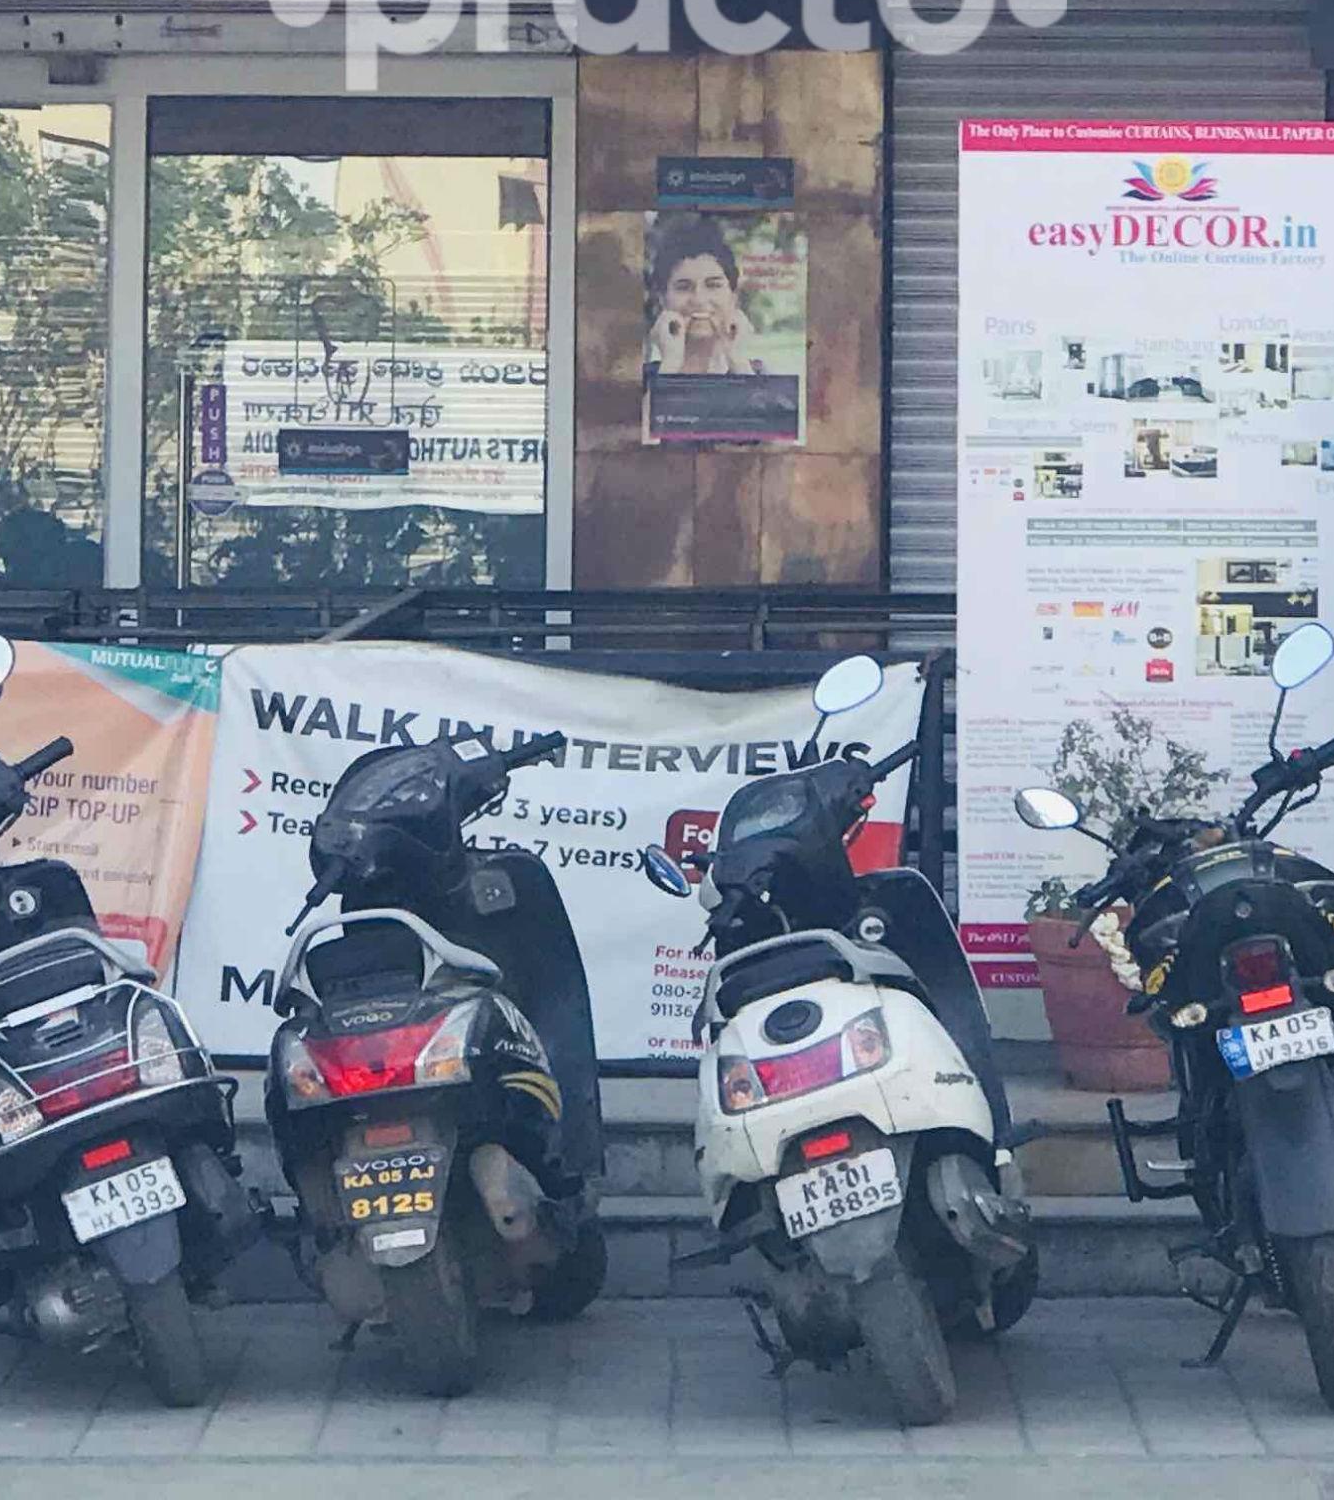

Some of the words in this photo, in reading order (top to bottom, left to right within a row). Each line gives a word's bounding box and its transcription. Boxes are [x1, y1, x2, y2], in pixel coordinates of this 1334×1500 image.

[1029, 214, 1318, 257] easyDECOR.in
[984, 316, 1037, 336] Paris
[90, 650, 165, 671] MUTUAL
[251, 688, 419, 748] WALK
[81, 772, 158, 795] number
[25, 794, 60, 818] SIP
[66, 798, 141, 825] TOP-UP
[513, 799, 530, 819] 3
[540, 804, 628, 831] years)
[268, 811, 315, 837] Tea
[558, 845, 646, 872] years)
[655, 945, 684, 959] For
[654, 964, 707, 980] Please
[1250, 1023, 1281, 1043] KA
[1287, 1013, 1319, 1035] 05
[343, 1173, 375, 1190] KA
[408, 1166, 435, 1182] AJ
[353, 1154, 427, 1174] VOGO
[89, 1180, 121, 1207] KA
[125, 1167, 158, 1193] 05
[351, 1191, 435, 1220] 8125
